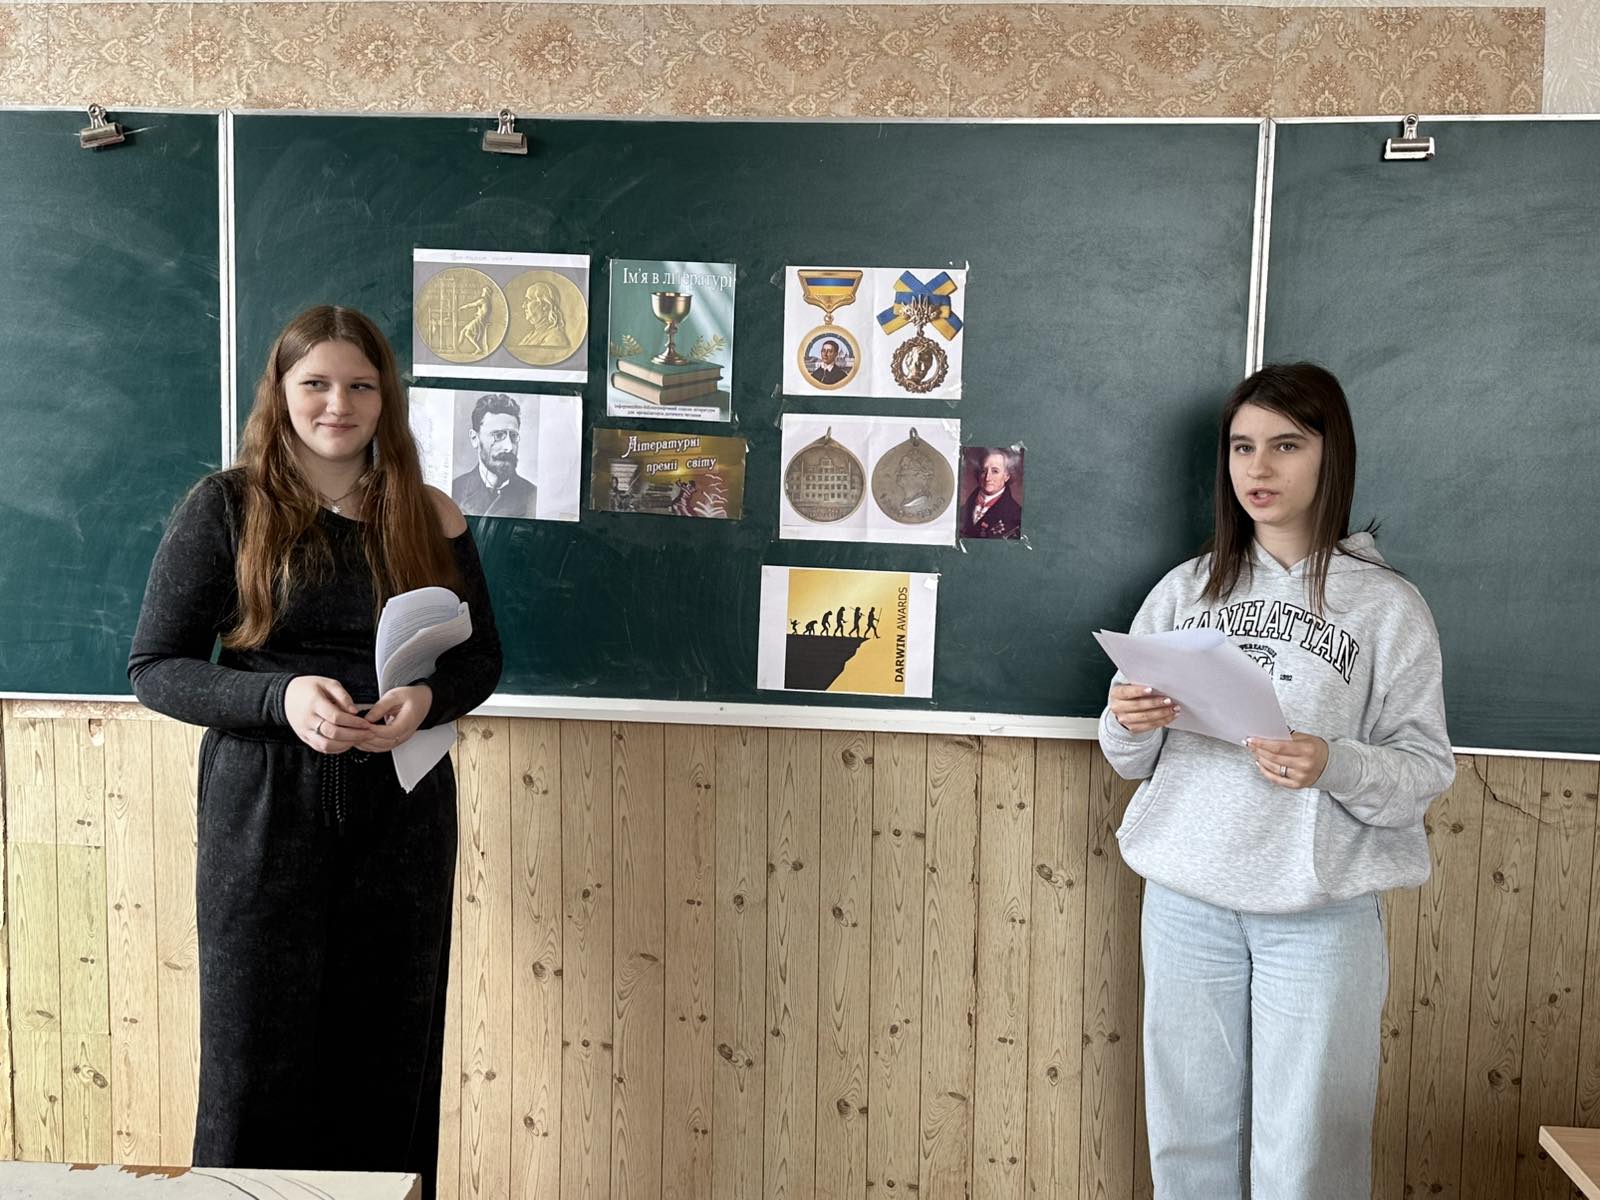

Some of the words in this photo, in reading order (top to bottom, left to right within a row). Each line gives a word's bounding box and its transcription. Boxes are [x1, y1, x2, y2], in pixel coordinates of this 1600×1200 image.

[623, 267, 649, 284] Ім'я
[652, 272, 660, 284] в
[621, 435, 700, 458] Літературні
[646, 459, 678, 475] премії
[686, 457, 717, 471] світу
[896, 586, 908, 631] AWARDS
[894, 634, 906, 683] DARWIN
[1175, 600, 1360, 685] ANHATTAN
